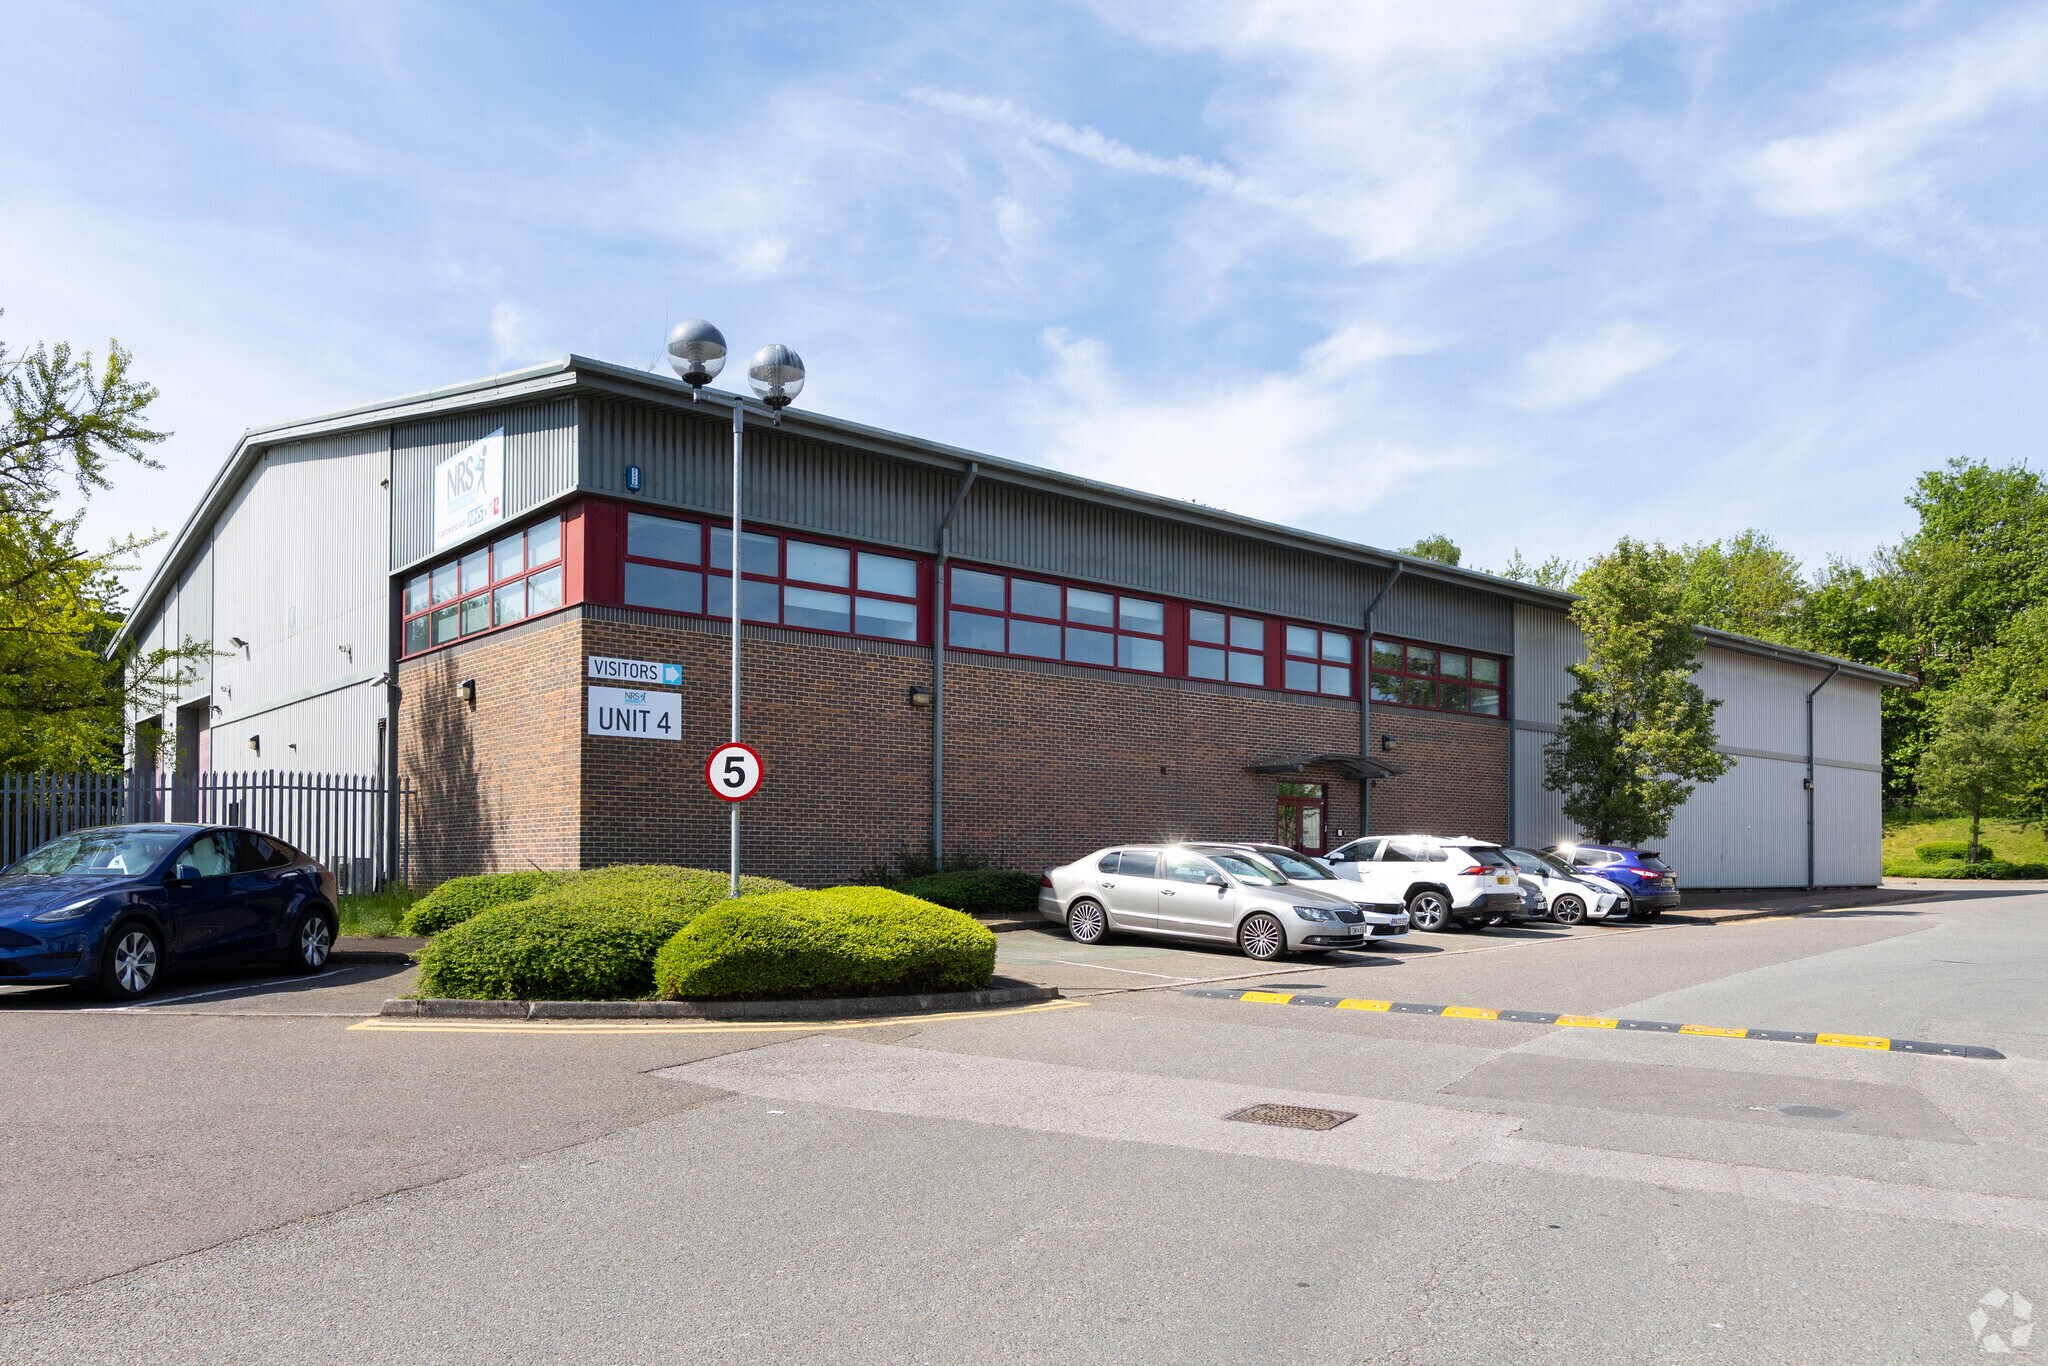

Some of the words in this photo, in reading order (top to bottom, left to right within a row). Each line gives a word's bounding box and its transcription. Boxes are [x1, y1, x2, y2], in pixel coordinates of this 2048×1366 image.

[447, 455, 474, 501] NRS
[594, 659, 658, 680] VISITORS
[624, 691, 640, 701] NRS
[599, 706, 650, 732] UNIT
[657, 712, 671, 734] 4
[723, 756, 746, 788] 5
